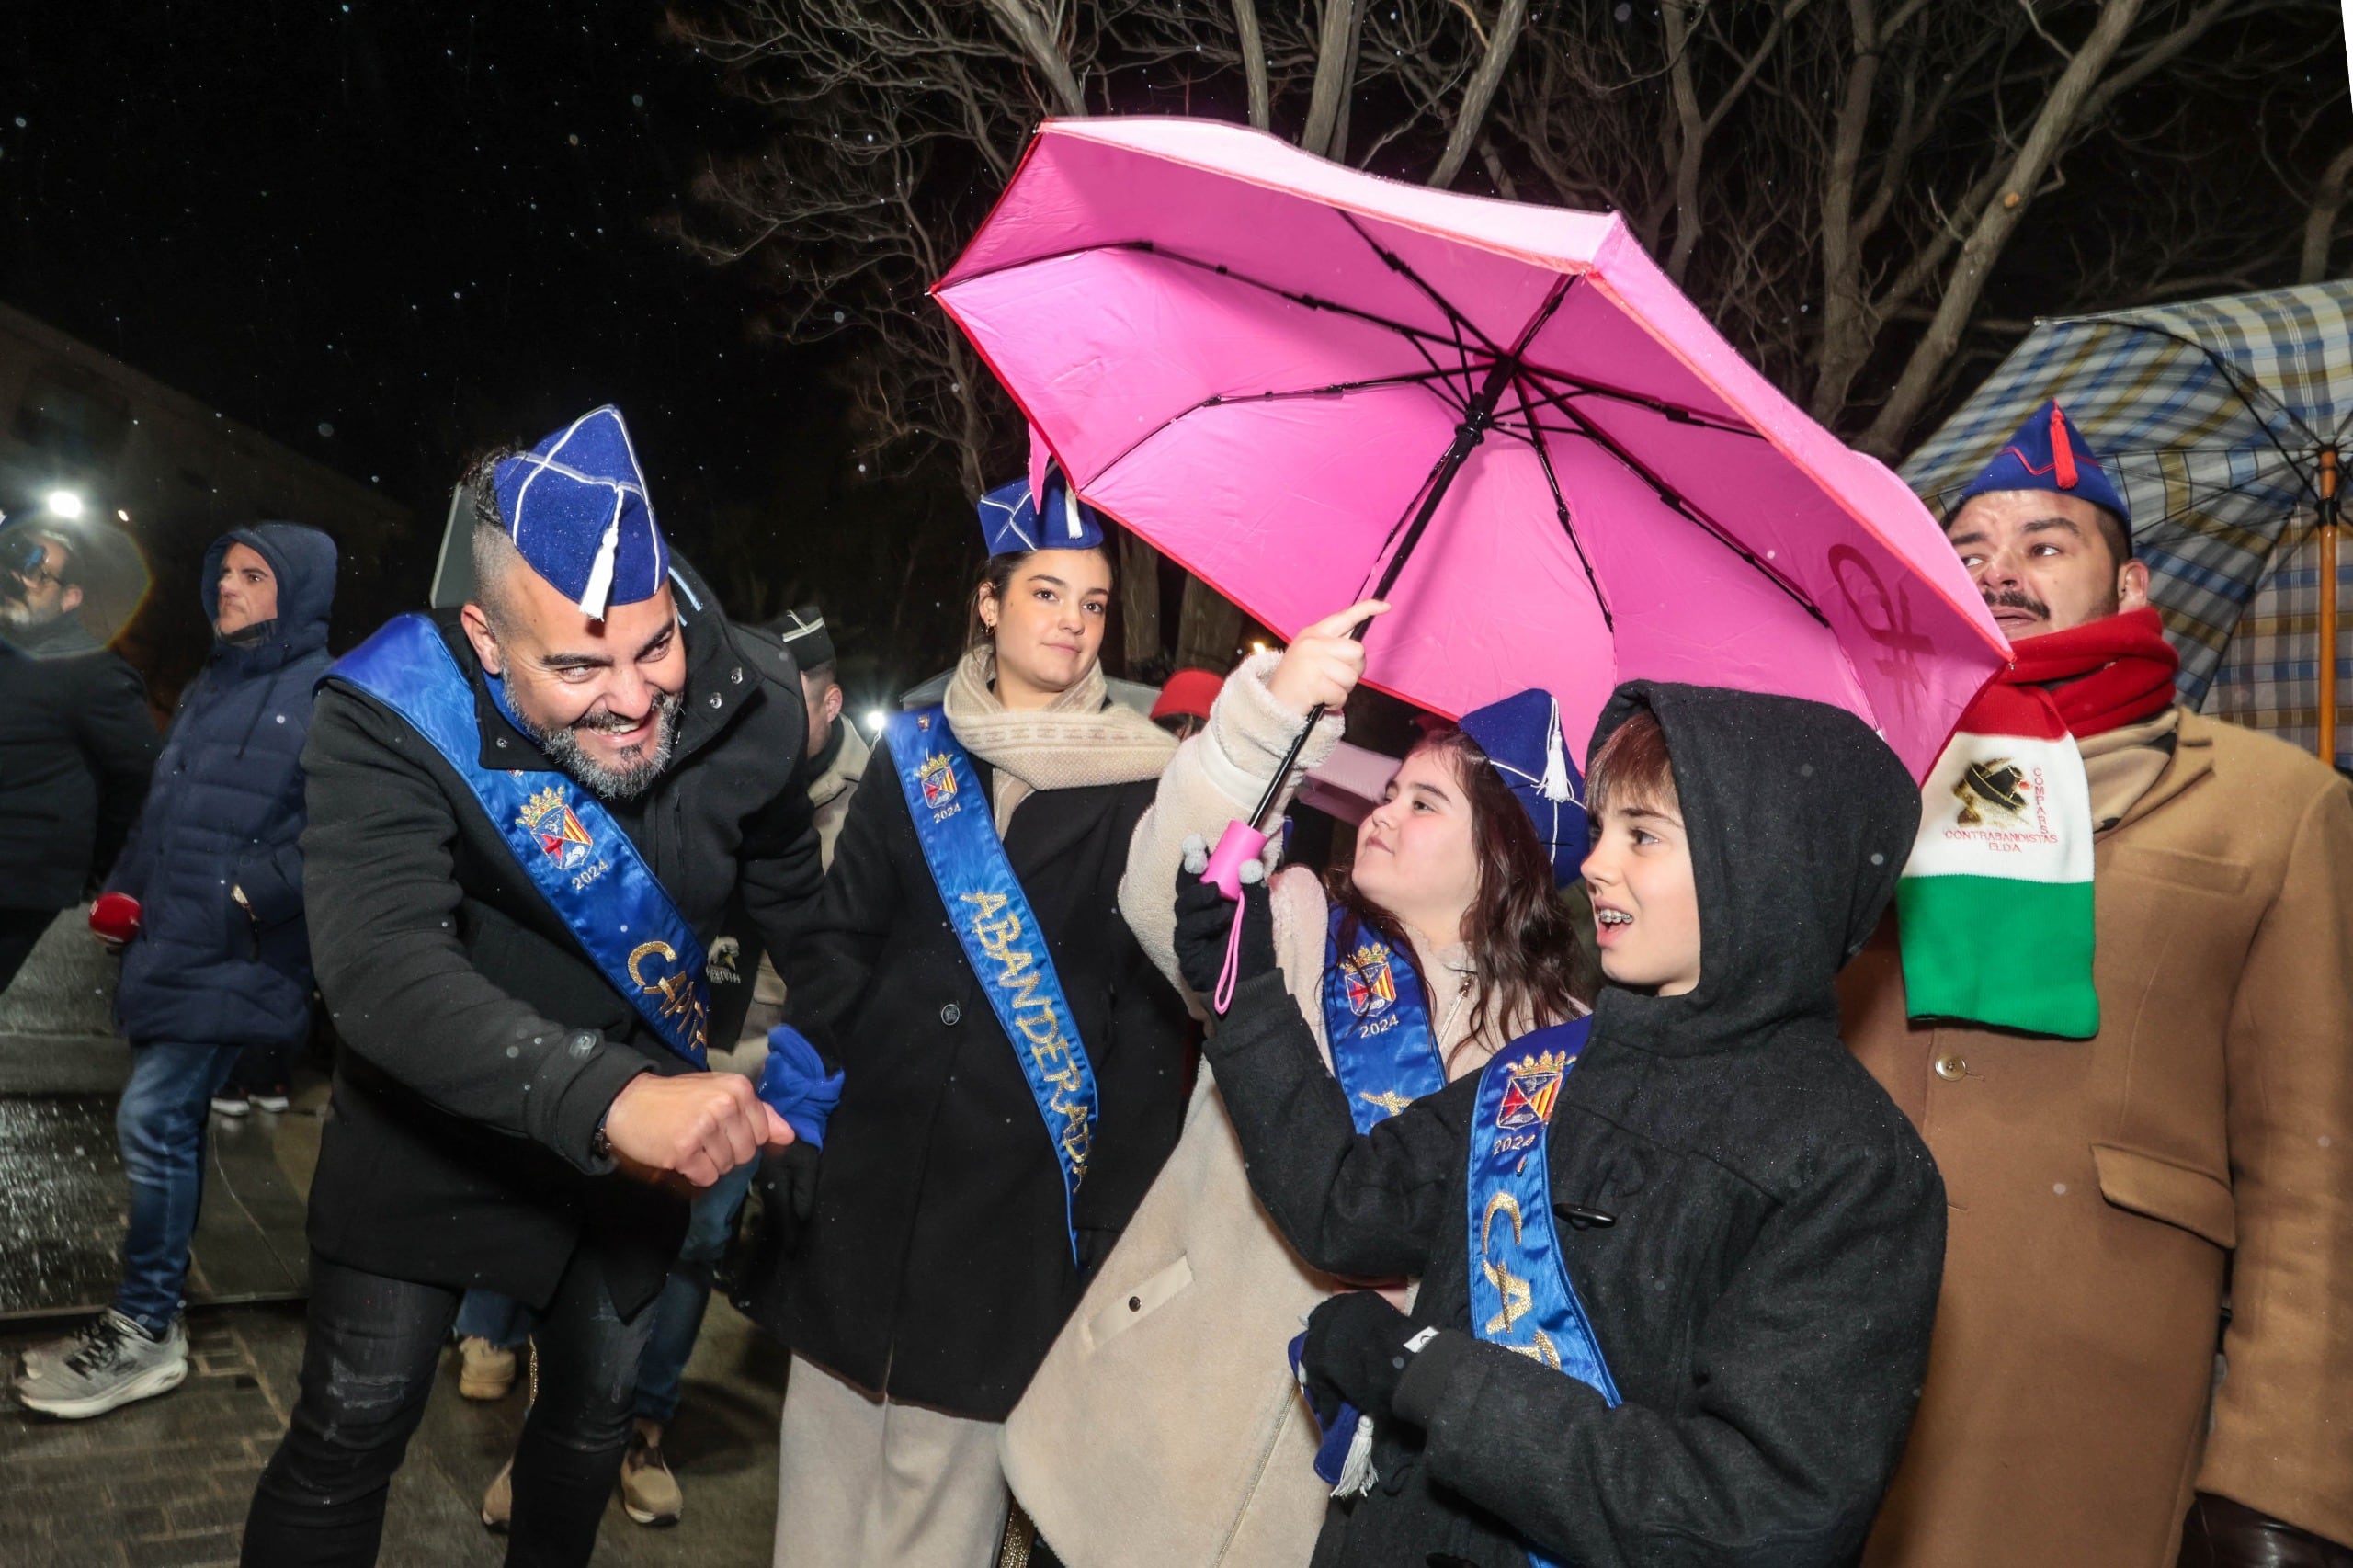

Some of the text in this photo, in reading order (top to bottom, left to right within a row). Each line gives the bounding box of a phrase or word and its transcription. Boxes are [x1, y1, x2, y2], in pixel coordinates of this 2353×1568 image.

[933, 803, 962, 824] 2024
[1988, 842, 2022, 854] ELDA
[571, 859, 609, 891] 2024
[1359, 1013, 1399, 1039] 2024
[1493, 1133, 1535, 1156] 2024
